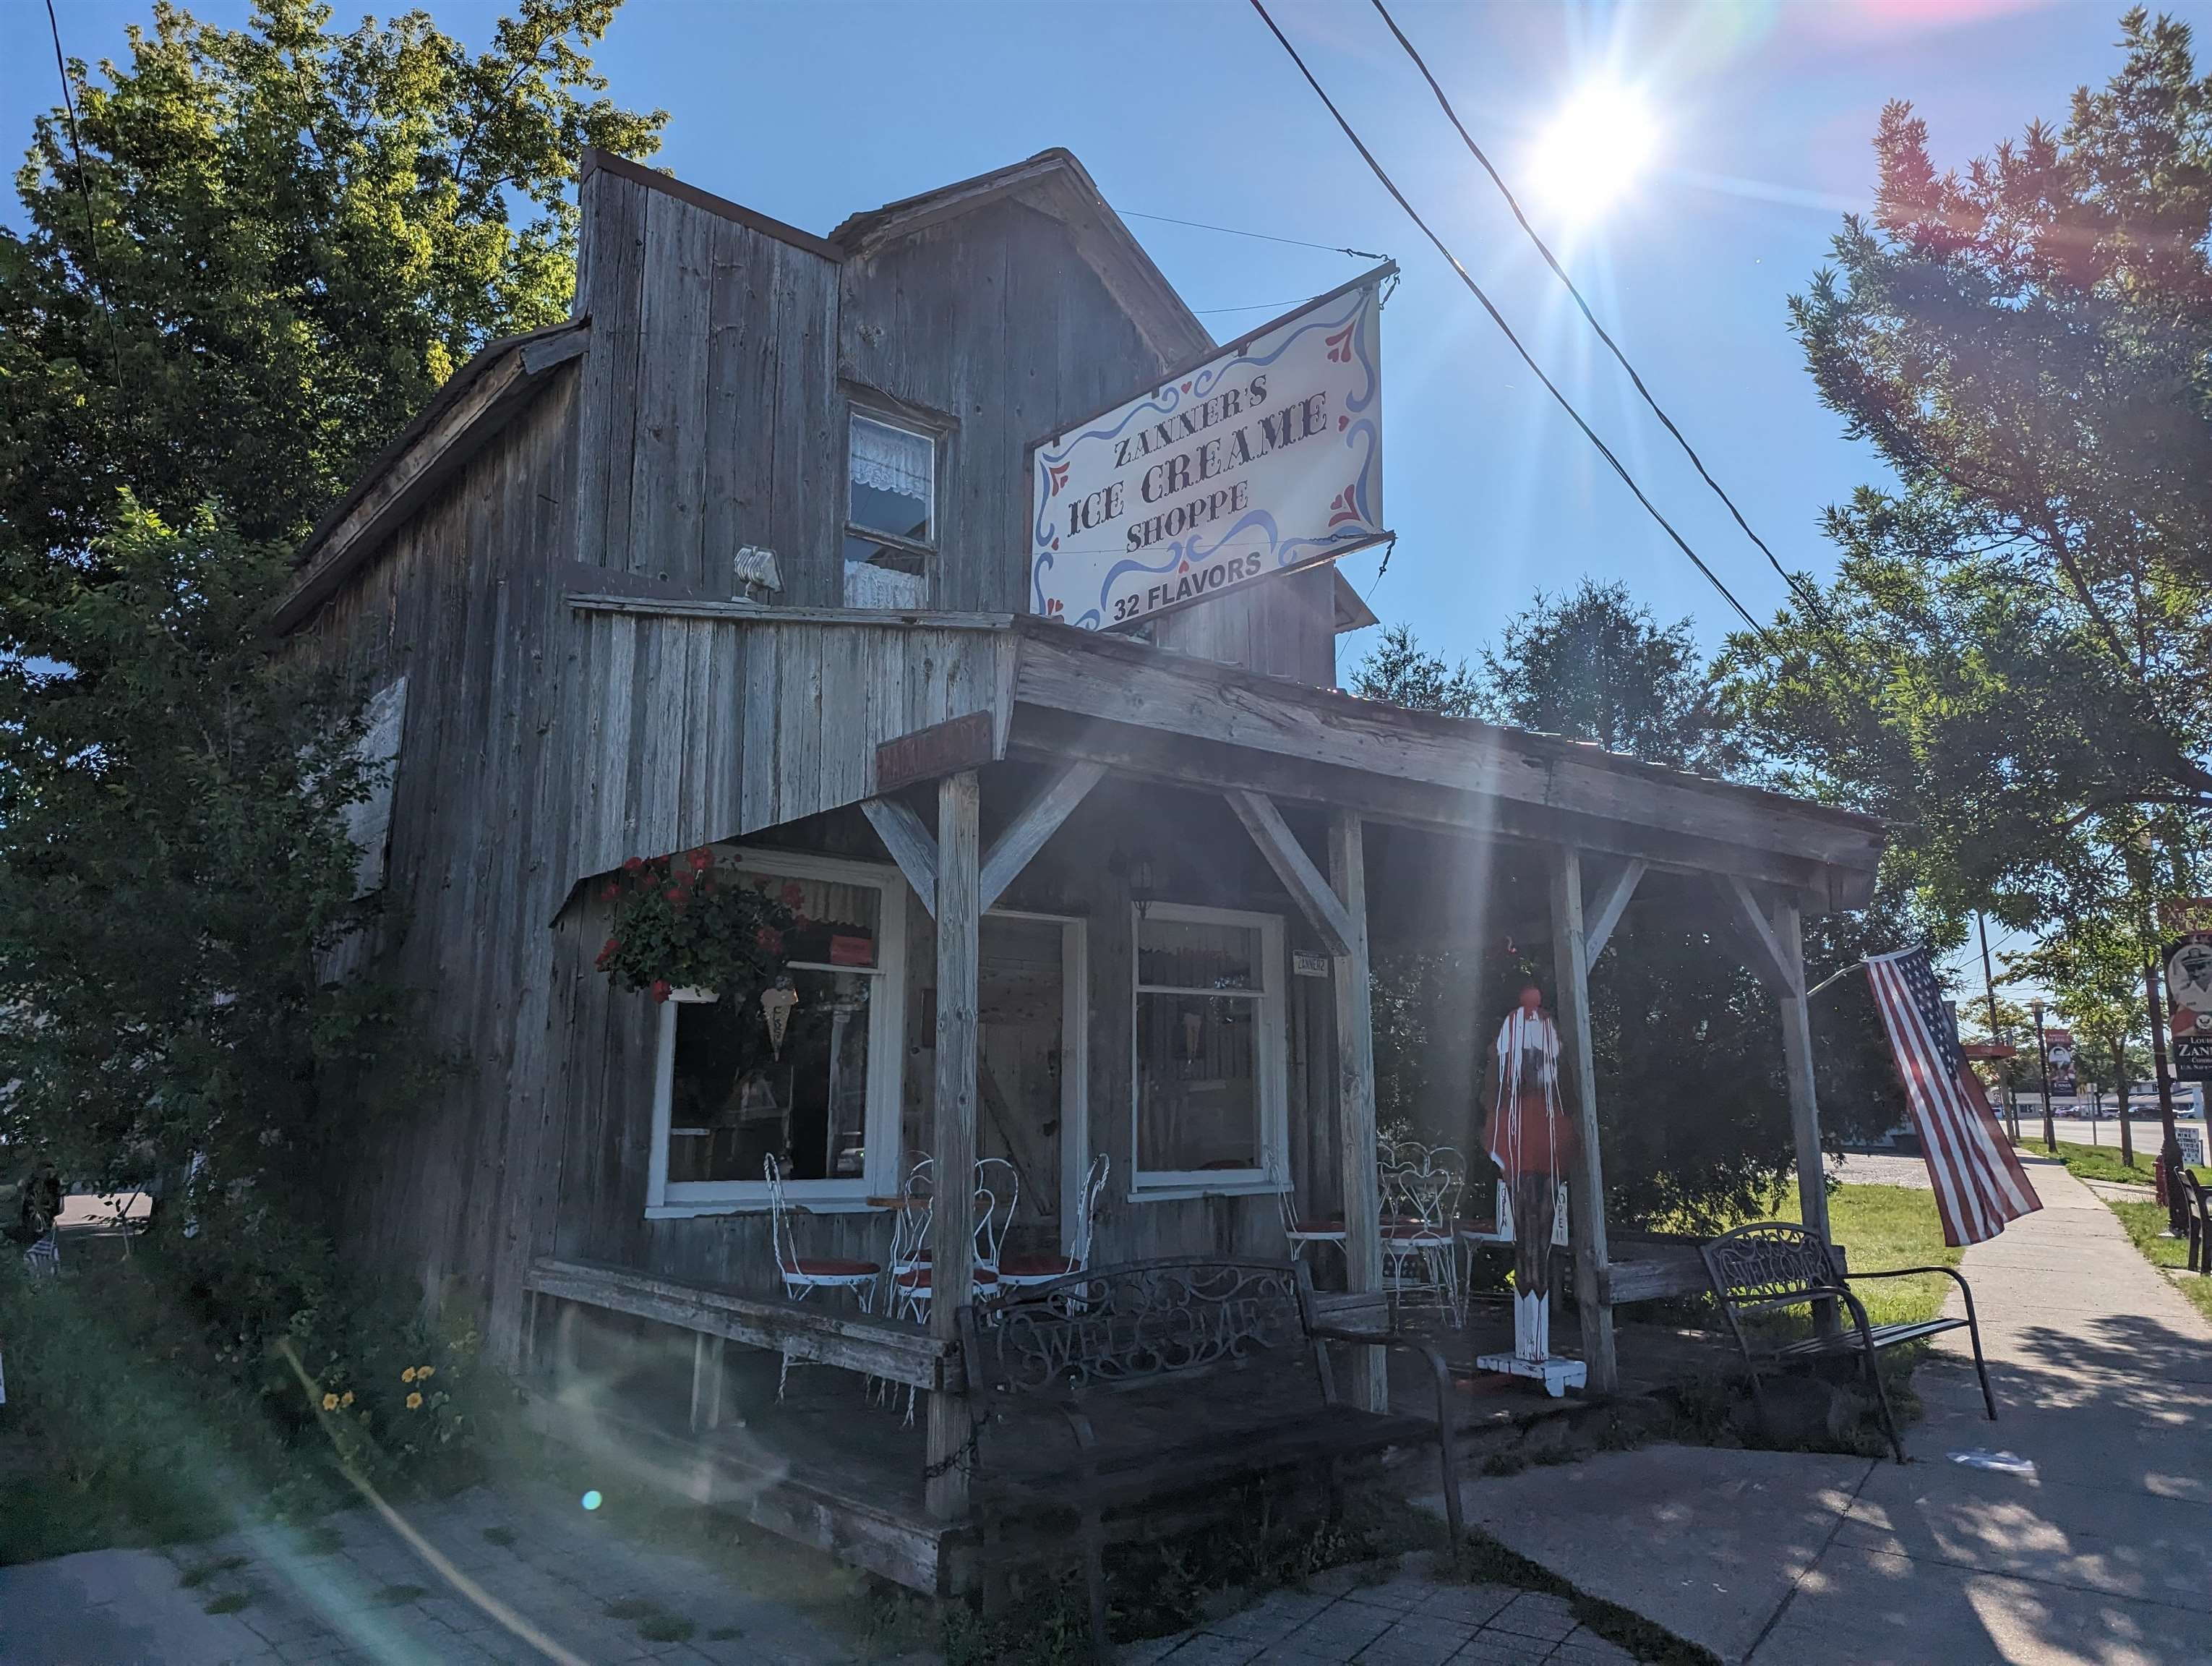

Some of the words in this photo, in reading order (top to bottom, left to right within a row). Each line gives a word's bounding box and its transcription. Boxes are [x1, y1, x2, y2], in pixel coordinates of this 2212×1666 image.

[1114, 374, 1267, 469] ZANNER'S
[1067, 480, 1125, 538] ICE
[1141, 390, 1327, 504] CREAME
[1126, 479, 1249, 553] SHOPPE
[1114, 594, 1139, 621] 32
[1148, 551, 1261, 610] FLAVORS
[1557, 1193, 1566, 1240] OPEN
[1731, 1252, 1818, 1286] WELCOME
[1030, 1297, 1259, 1365] WELCOME
